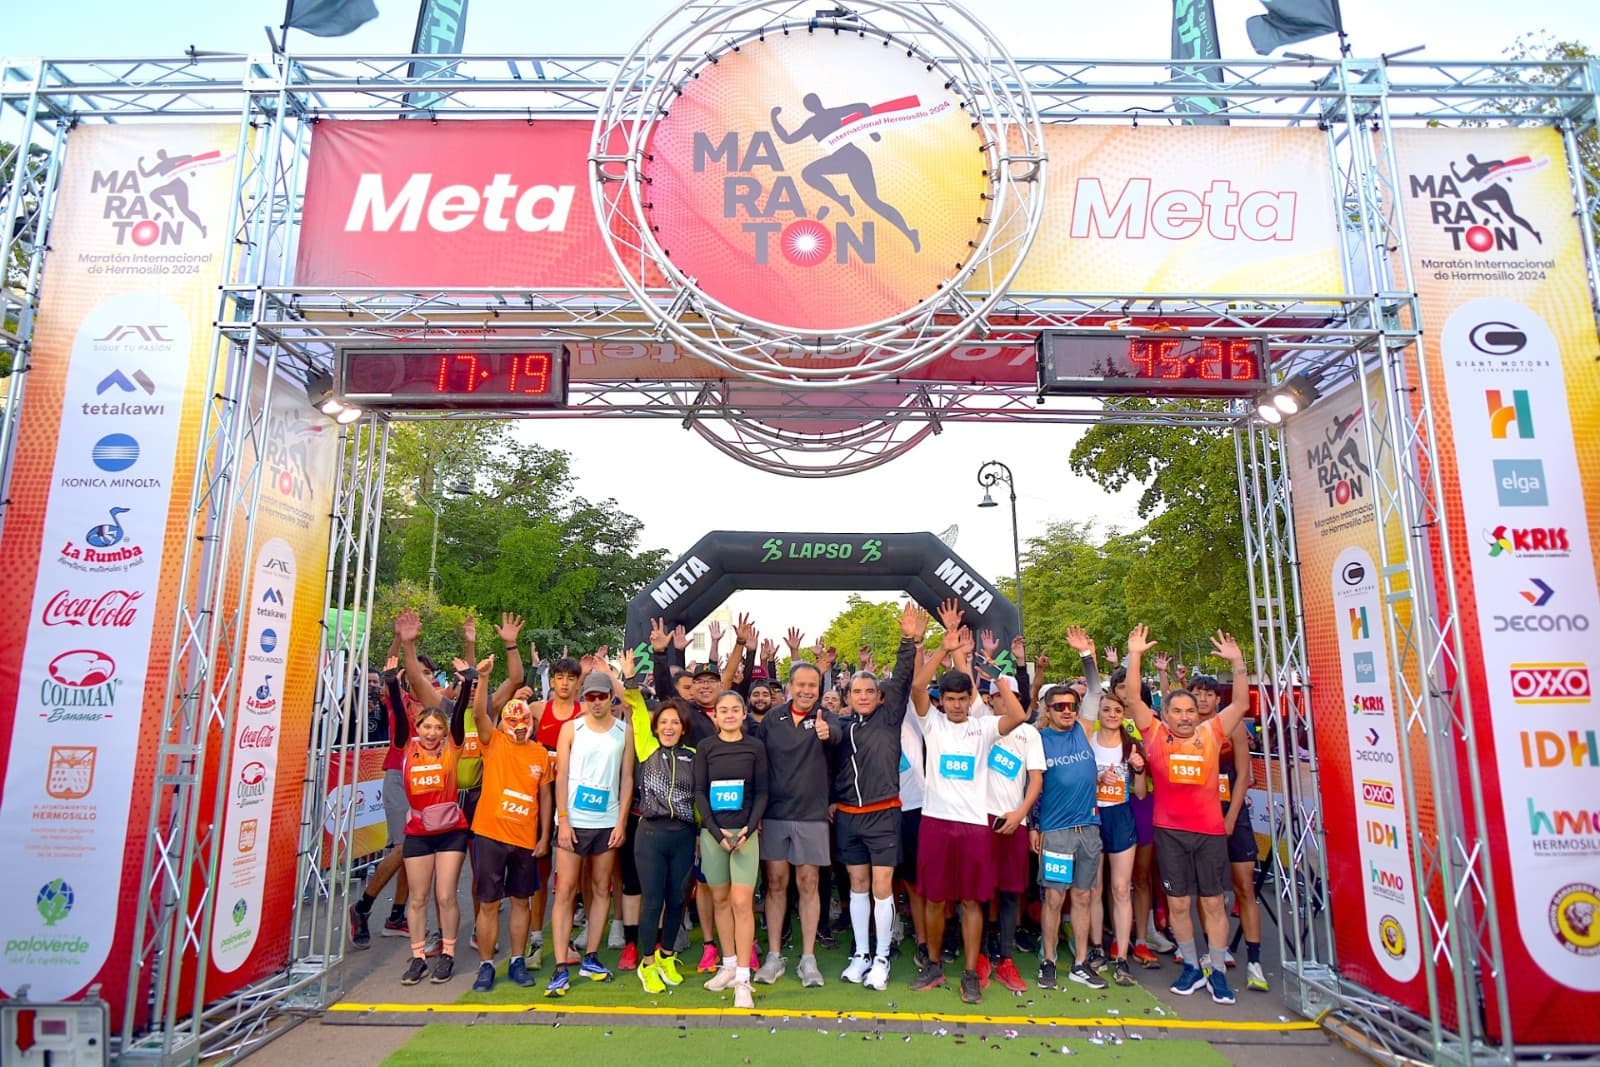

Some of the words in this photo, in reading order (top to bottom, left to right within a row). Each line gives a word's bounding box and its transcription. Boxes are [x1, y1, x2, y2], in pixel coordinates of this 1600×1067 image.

[828, 119, 882, 145] Internacional
[883, 111, 929, 125] Hermosillo
[929, 100, 951, 115] 2024
[693, 131, 785, 172] MA
[90, 169, 141, 194] MA
[1409, 174, 1461, 199] MA
[344, 173, 576, 233] Meta
[724, 176, 807, 218] RA
[103, 195, 150, 220] RA
[1070, 178, 1298, 241] Meta
[1430, 200, 1477, 225] RA
[78, 253, 130, 264] Maratón
[132, 252, 212, 264] Internacional
[1421, 259, 1473, 270] Maratón
[1474, 258, 1556, 270] Internacional
[87, 265, 104, 275] de
[105, 264, 170, 275] Hermosillo
[171, 265, 200, 275] 2024
[1433, 270, 1449, 281] de
[1451, 270, 1516, 281] Hermosillo
[1517, 271, 1547, 281] 2024
[82, 402, 164, 416] tetakawi
[1307, 441, 1333, 470] MA
[61, 478, 108, 488] KONICA
[110, 478, 161, 488] MINOLTA
[1317, 461, 1342, 488] RA
[1502, 470, 1540, 493] elga
[1512, 527, 1569, 552] KRIS
[61, 541, 80, 559] La
[84, 545, 143, 562] Rumba
[788, 542, 853, 560] LAPSO
[650, 555, 711, 610] META
[933, 557, 995, 615] META
[257, 607, 287, 620] tetakawi
[1493, 614, 1590, 632] DECONO
[41, 677, 118, 707] COLIMAN
[1513, 669, 1589, 697] OXXO
[247, 696, 255, 707] La
[1361, 696, 1385, 711] KRIS
[47, 708, 104, 723] Bananas
[1356, 749, 1394, 764] DECONO
[1520, 730, 1600, 768] IDH
[946, 759, 969, 772] 886
[993, 752, 1016, 771] 885
[1171, 765, 1201, 777] 1351
[411, 774, 441, 788] 1483
[581, 792, 603, 805] 734
[716, 791, 738, 802] 760
[1363, 784, 1394, 803] OXXO
[32, 812, 97, 821] HERMOSILLO
[501, 800, 529, 817] 1244
[1366, 820, 1398, 849] IDH
[1533, 839, 1600, 850] HERMOSIL
[1045, 862, 1067, 874] 682
[4, 935, 89, 956] paloverde
